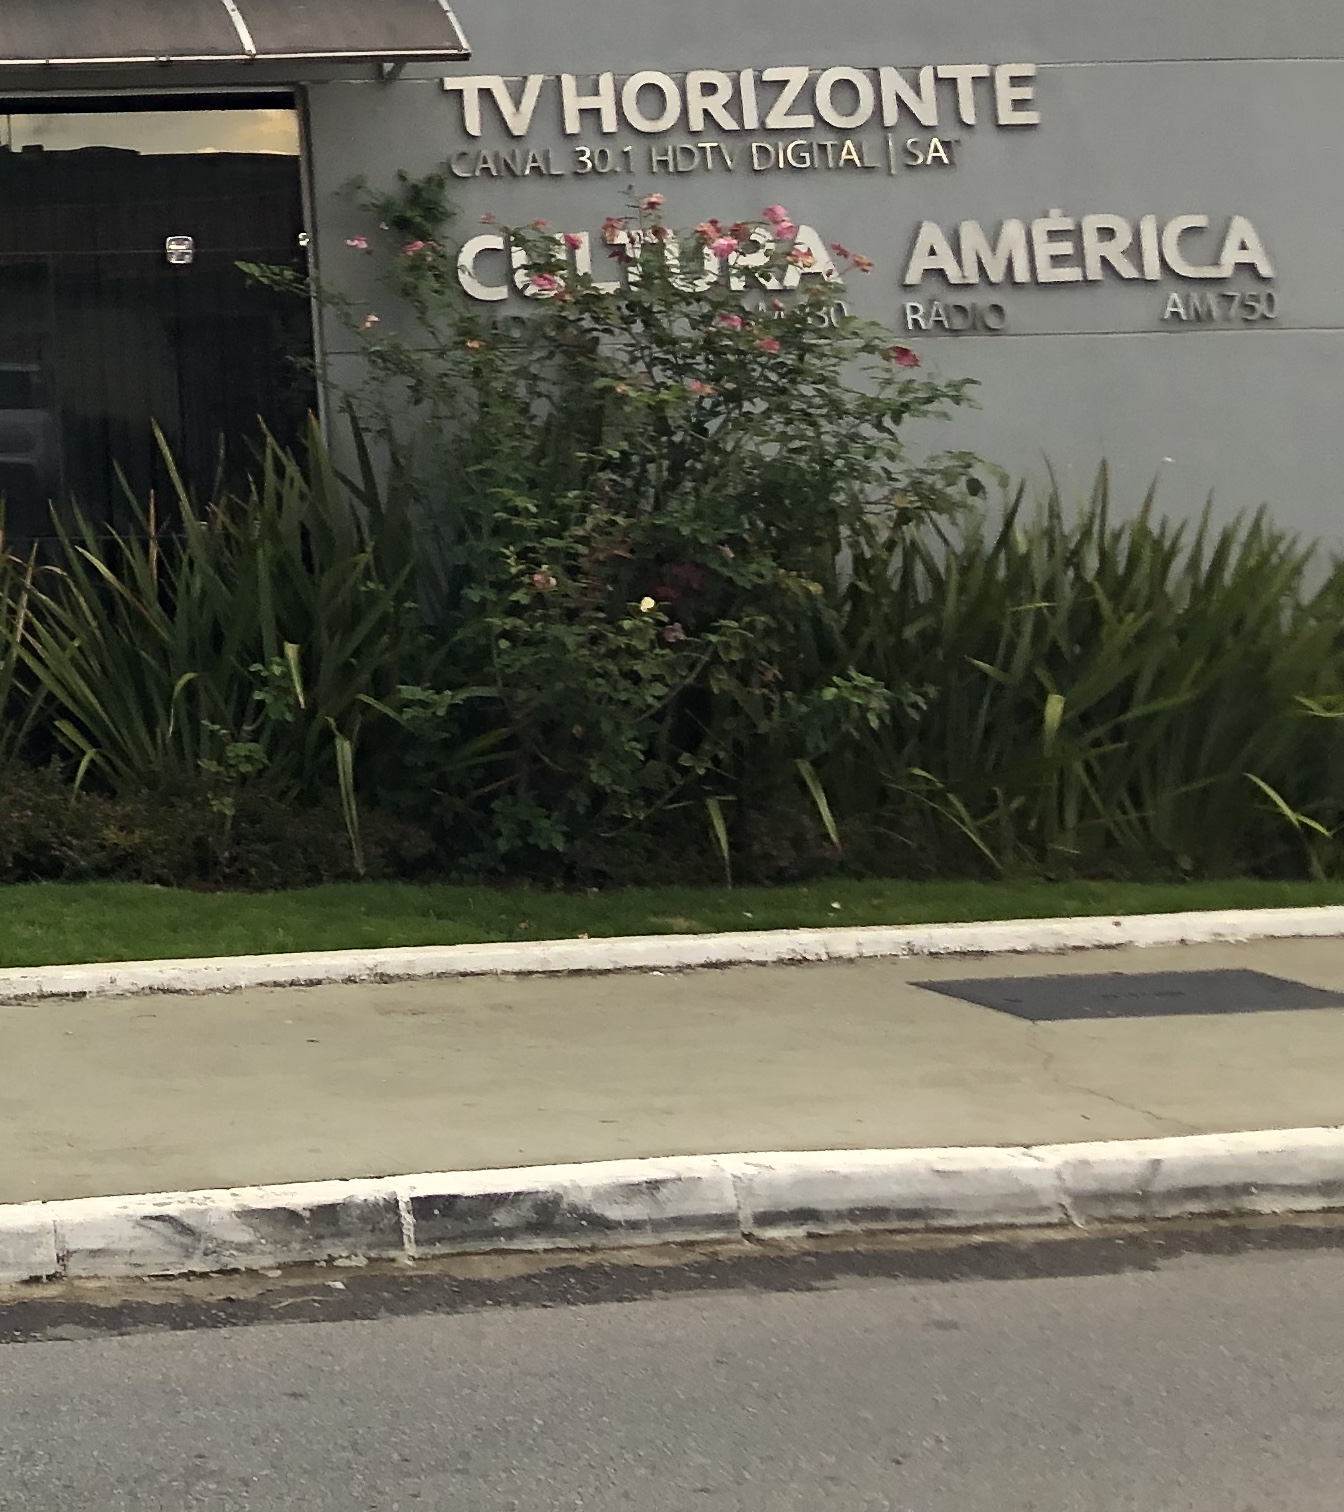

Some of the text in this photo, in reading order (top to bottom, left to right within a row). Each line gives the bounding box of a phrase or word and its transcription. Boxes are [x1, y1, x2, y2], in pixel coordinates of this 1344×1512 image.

[443, 62, 1041, 137] TV HORIZONTE
[450, 148, 564, 177] CANAL
[574, 145, 634, 174] 30.1
[651, 142, 736, 173] HDTV
[751, 139, 881, 171] DIGITAL
[903, 208, 1274, 285] AMÉRICA
